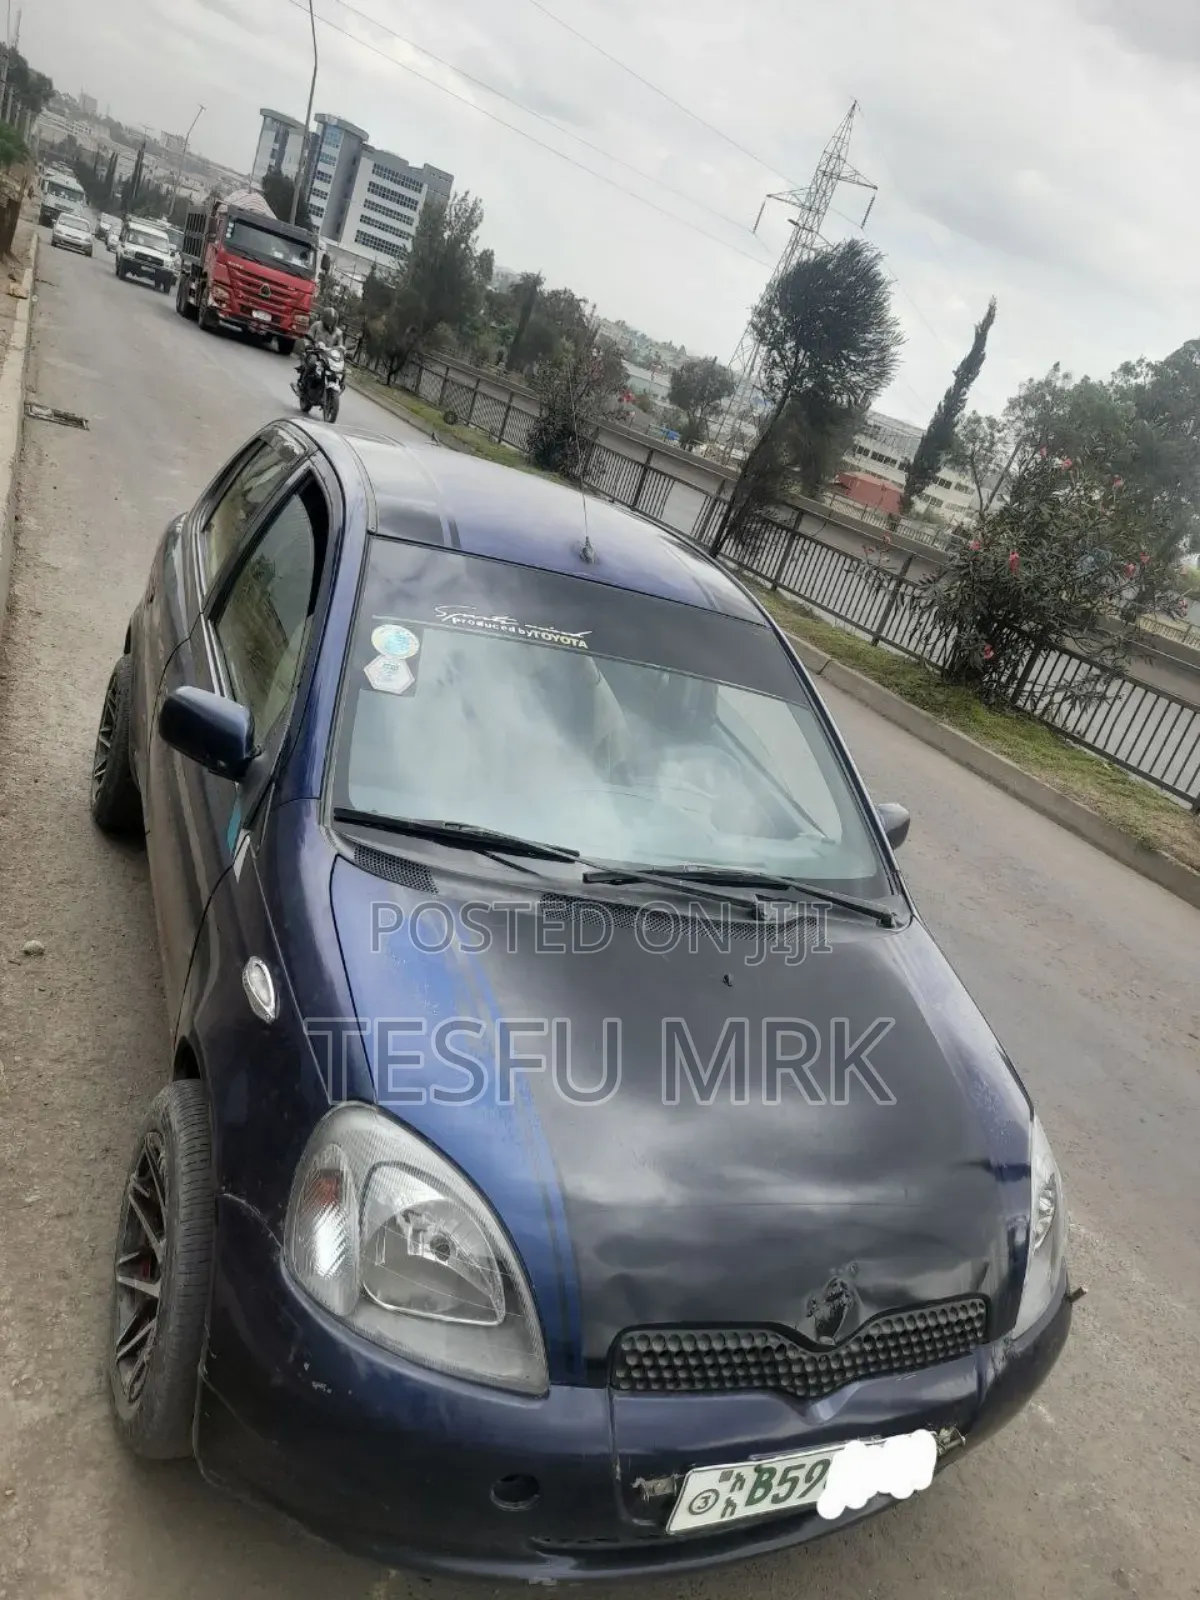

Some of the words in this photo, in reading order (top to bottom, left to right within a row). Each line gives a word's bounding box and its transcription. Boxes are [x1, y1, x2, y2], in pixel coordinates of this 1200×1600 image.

[452, 616, 516, 633] produced
[531, 631, 589, 649] TOYOTA
[745, 1458, 831, 1507] B59
